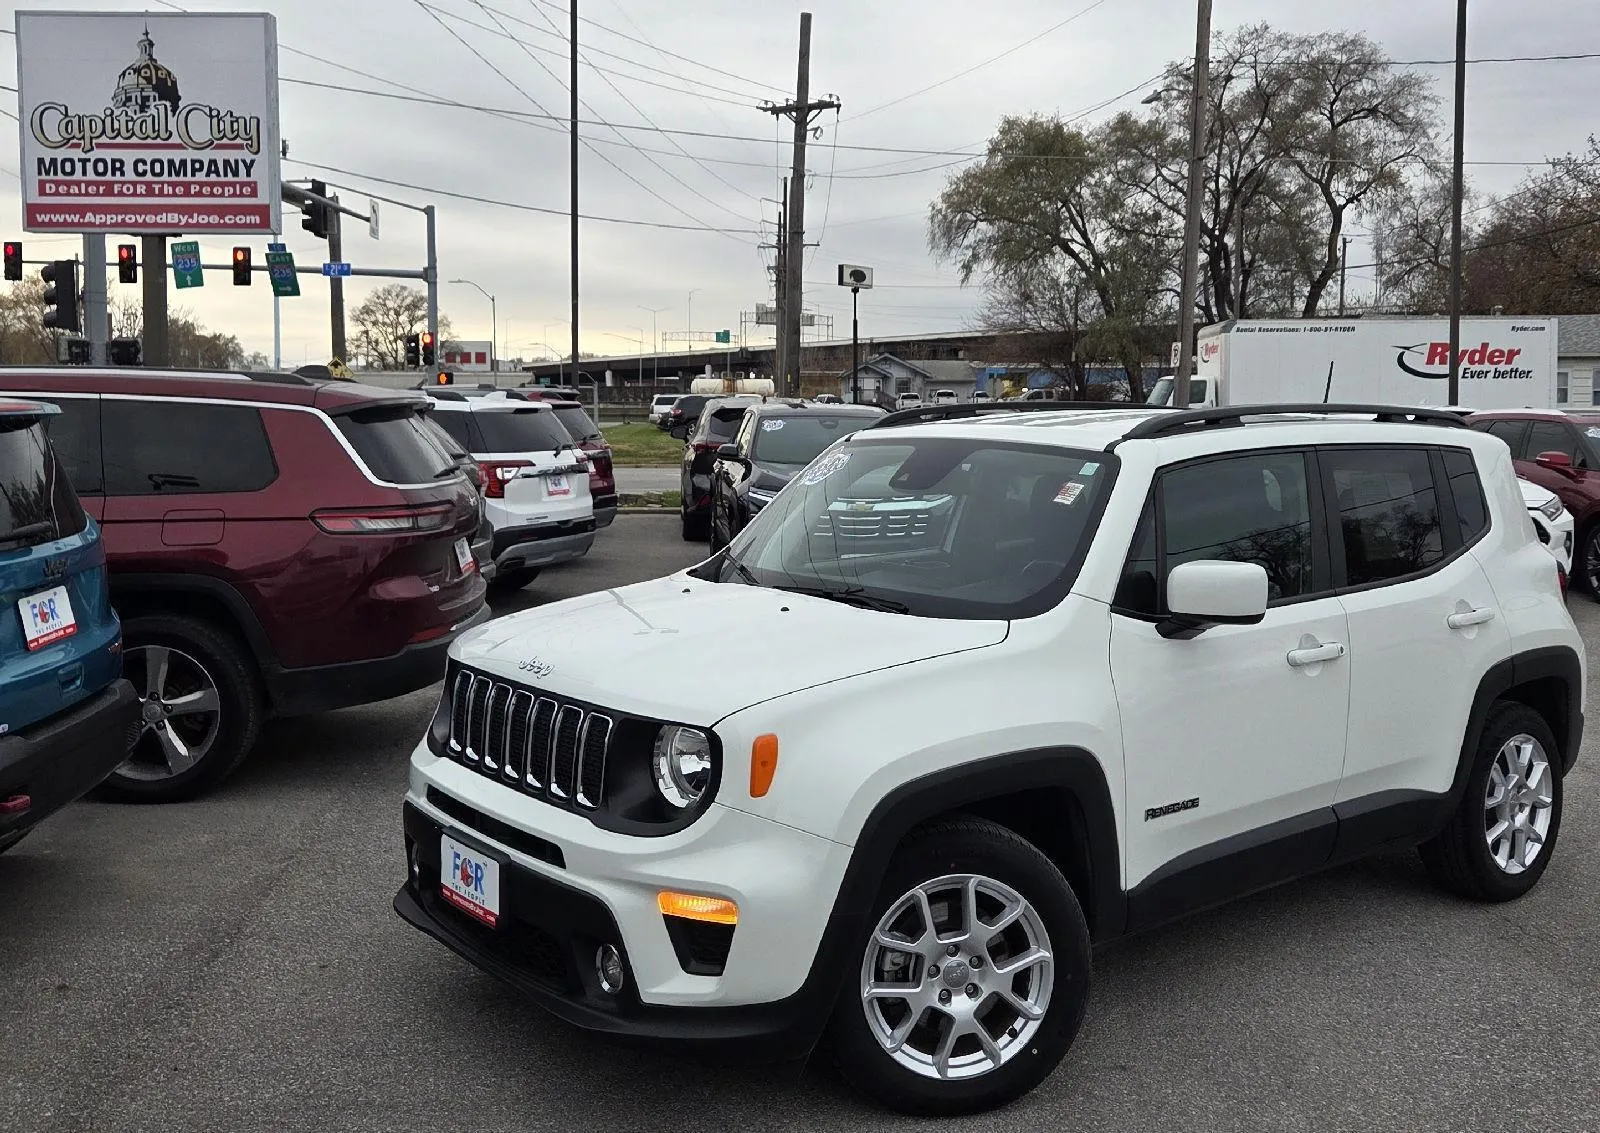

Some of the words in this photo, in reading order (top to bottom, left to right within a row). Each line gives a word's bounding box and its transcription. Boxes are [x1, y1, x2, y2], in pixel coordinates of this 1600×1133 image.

[31, 101, 171, 154] Capital
[176, 102, 260, 155] City
[37, 157, 126, 177] MOTOR
[133, 158, 256, 178] COMPANY
[45, 182, 105, 195] Dealer
[114, 183, 147, 195] FOR
[152, 183, 184, 195] The
[190, 184, 252, 197] People
[36, 211, 260, 226] www.ApprovedByJoe.com
[177, 257, 197, 269] 235
[1205, 341, 1219, 358] Ryder
[1461, 367, 1490, 379] Ever
[1493, 366, 1533, 379] better.
